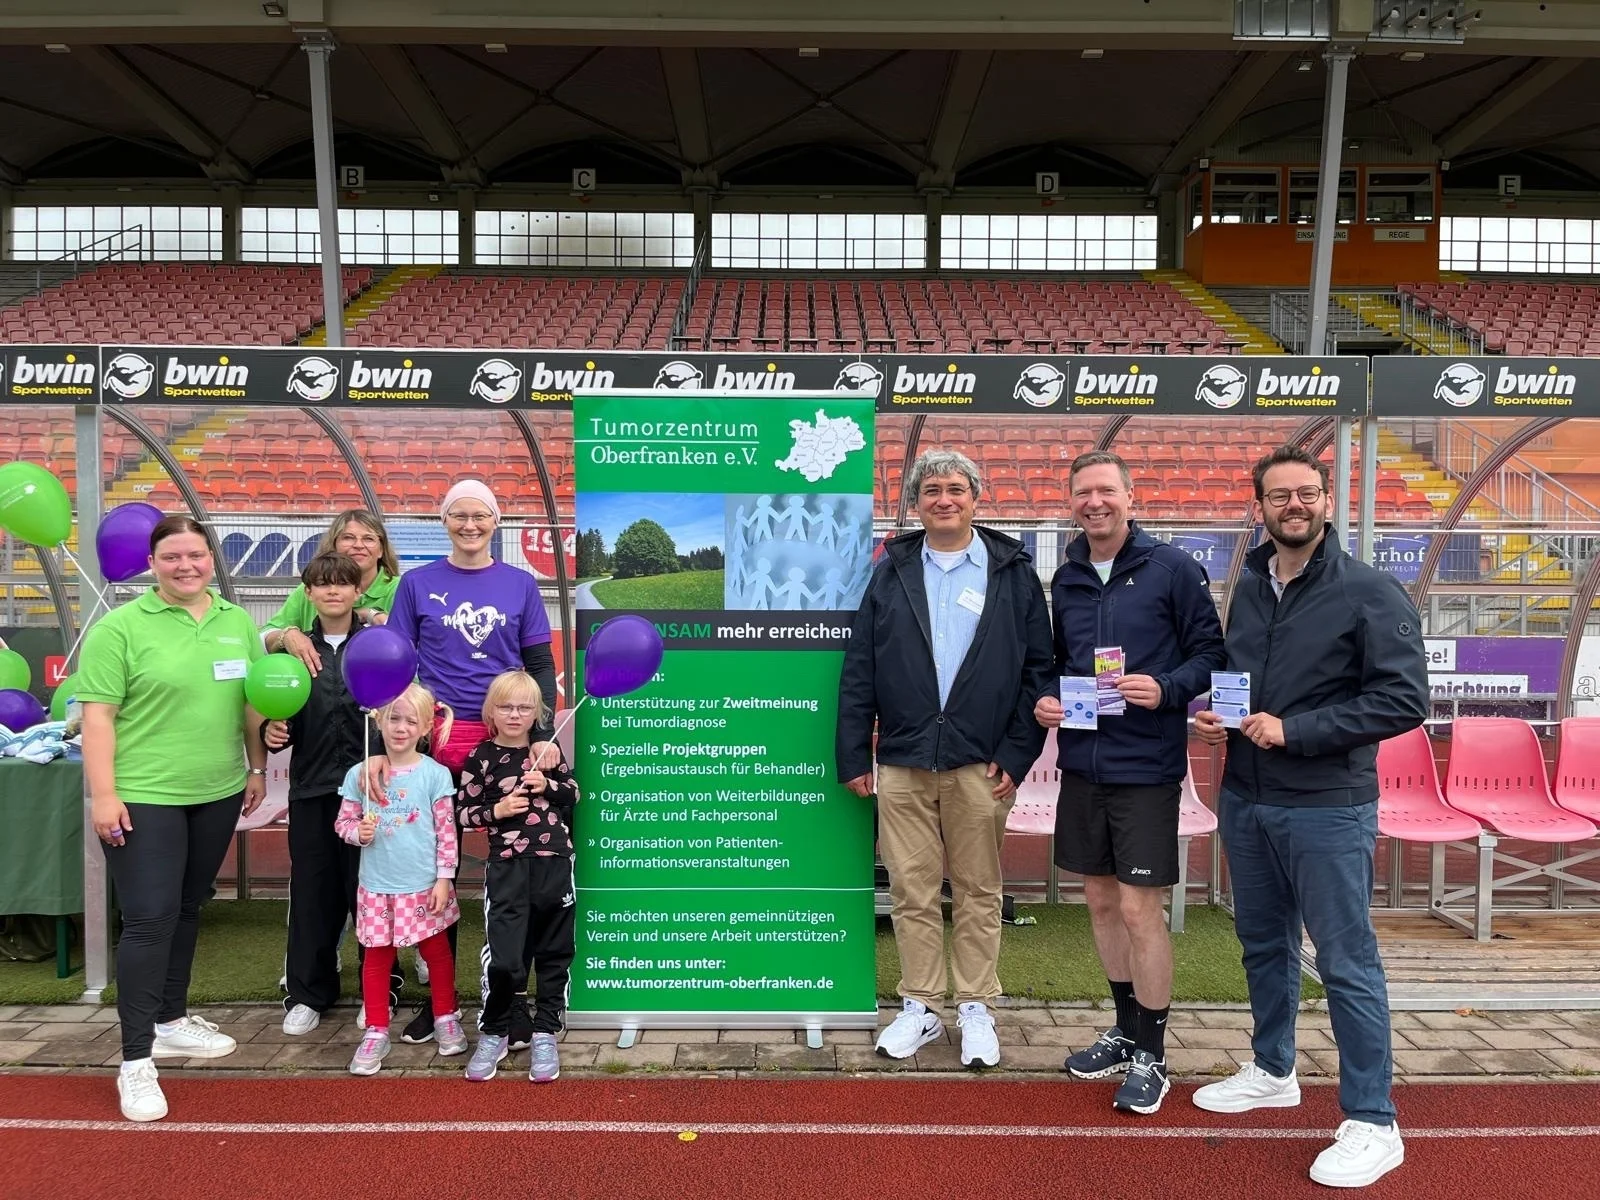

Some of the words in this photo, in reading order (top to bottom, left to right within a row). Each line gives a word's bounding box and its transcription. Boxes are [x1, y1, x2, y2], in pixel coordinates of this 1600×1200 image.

[346, 168, 359, 186] B
[577, 171, 590, 189] C
[1041, 175, 1055, 193] D
[1503, 177, 1516, 195] E
[1388, 231, 1410, 239] REGIE
[13, 355, 95, 384] bwin
[164, 356, 249, 387] bwin
[349, 359, 433, 390] bwin
[531, 361, 615, 390] bwin
[713, 362, 796, 390] bwin
[892, 363, 976, 394] bwin
[1075, 365, 1158, 395] bwin
[1256, 366, 1340, 396] bwin
[1495, 365, 1576, 396] bwin
[12, 386, 92, 396] Sportwetten
[163, 387, 246, 398] Sportwetten
[348, 390, 430, 401] Sportwetten
[892, 395, 973, 406] Sportwetten
[1074, 396, 1155, 407] Sportwetten
[1256, 397, 1337, 408] Sportwetten
[1494, 396, 1573, 406] Sportwetten
[590, 418, 758, 437] Tumorzentrum
[591, 446, 718, 465] Oberfranken
[724, 448, 758, 465] e.V.
[717, 622, 765, 639] mehr
[768, 622, 852, 639] erreichen
[601, 697, 696, 712] Unterstützung
[699, 699, 720, 709] zur
[722, 697, 819, 712] Zweitmeinung
[601, 716, 622, 728] bei
[625, 716, 727, 731] Tumordiagnose
[601, 743, 659, 759] Spezielle
[662, 743, 767, 759] Projektgruppen
[601, 763, 727, 778] (Ergebnisaustausch
[730, 763, 751, 775] für
[754, 763, 826, 778] Behandler)
[600, 790, 684, 805] Organisation
[687, 792, 712, 802] von
[715, 790, 825, 805] Weiterbildungen
[600, 809, 620, 822] für
[623, 808, 658, 822] Ärzte
[662, 809, 688, 822] und
[691, 809, 778, 824] Fachpersonal
[600, 837, 684, 851] Organisation
[687, 839, 712, 849] von
[716, 837, 784, 849] Patienten-
[600, 856, 790, 871] informationsveranstaltungen
[586, 910, 606, 922] Sie
[610, 910, 669, 922] möchten
[672, 912, 726, 922] unseren
[729, 910, 835, 925] gemeinnützigen
[586, 930, 629, 942] Verein
[633, 930, 658, 942] und
[662, 932, 708, 942] unsere
[711, 930, 752, 942] Arbeit
[756, 930, 847, 942] unterstützen?
[586, 957, 607, 969] Sie
[609, 957, 654, 969] finden
[657, 959, 682, 969] uns
[685, 957, 726, 969] unter:
[586, 976, 834, 989] www.tumorzentrum-oberfranken.de
